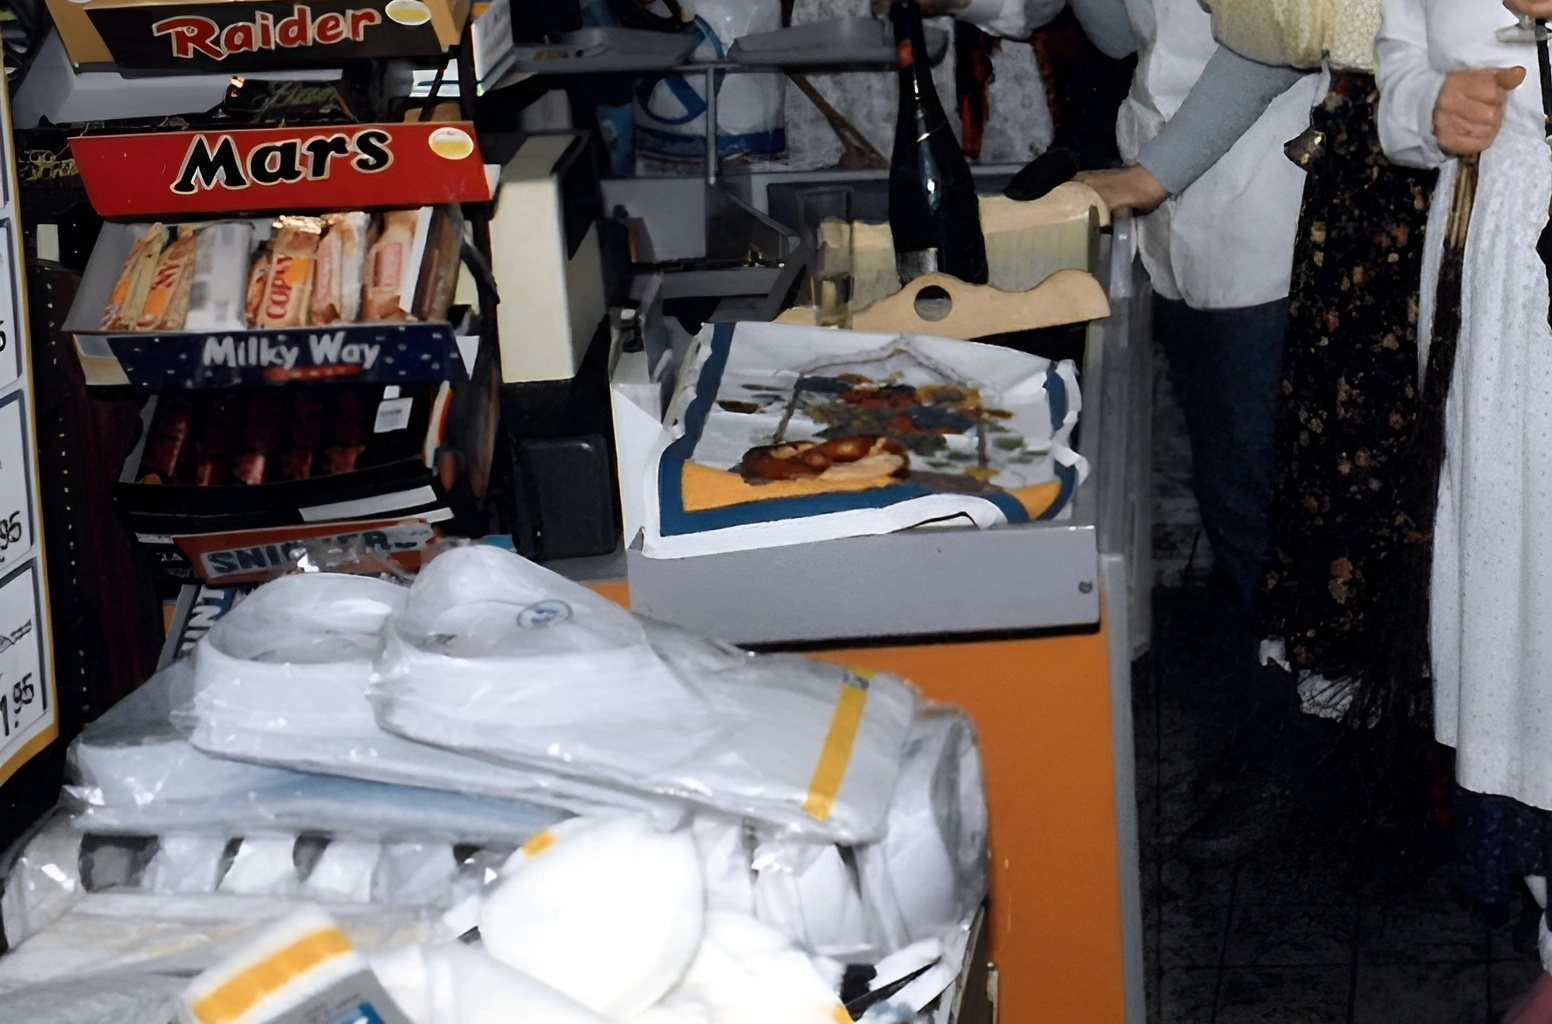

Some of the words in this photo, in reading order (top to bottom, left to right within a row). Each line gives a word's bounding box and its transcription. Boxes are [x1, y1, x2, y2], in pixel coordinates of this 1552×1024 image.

[151, 4, 382, 62] Raider
[169, 128, 394, 195] Mars
[203, 334, 300, 373] Milky
[308, 330, 381, 369] Way
